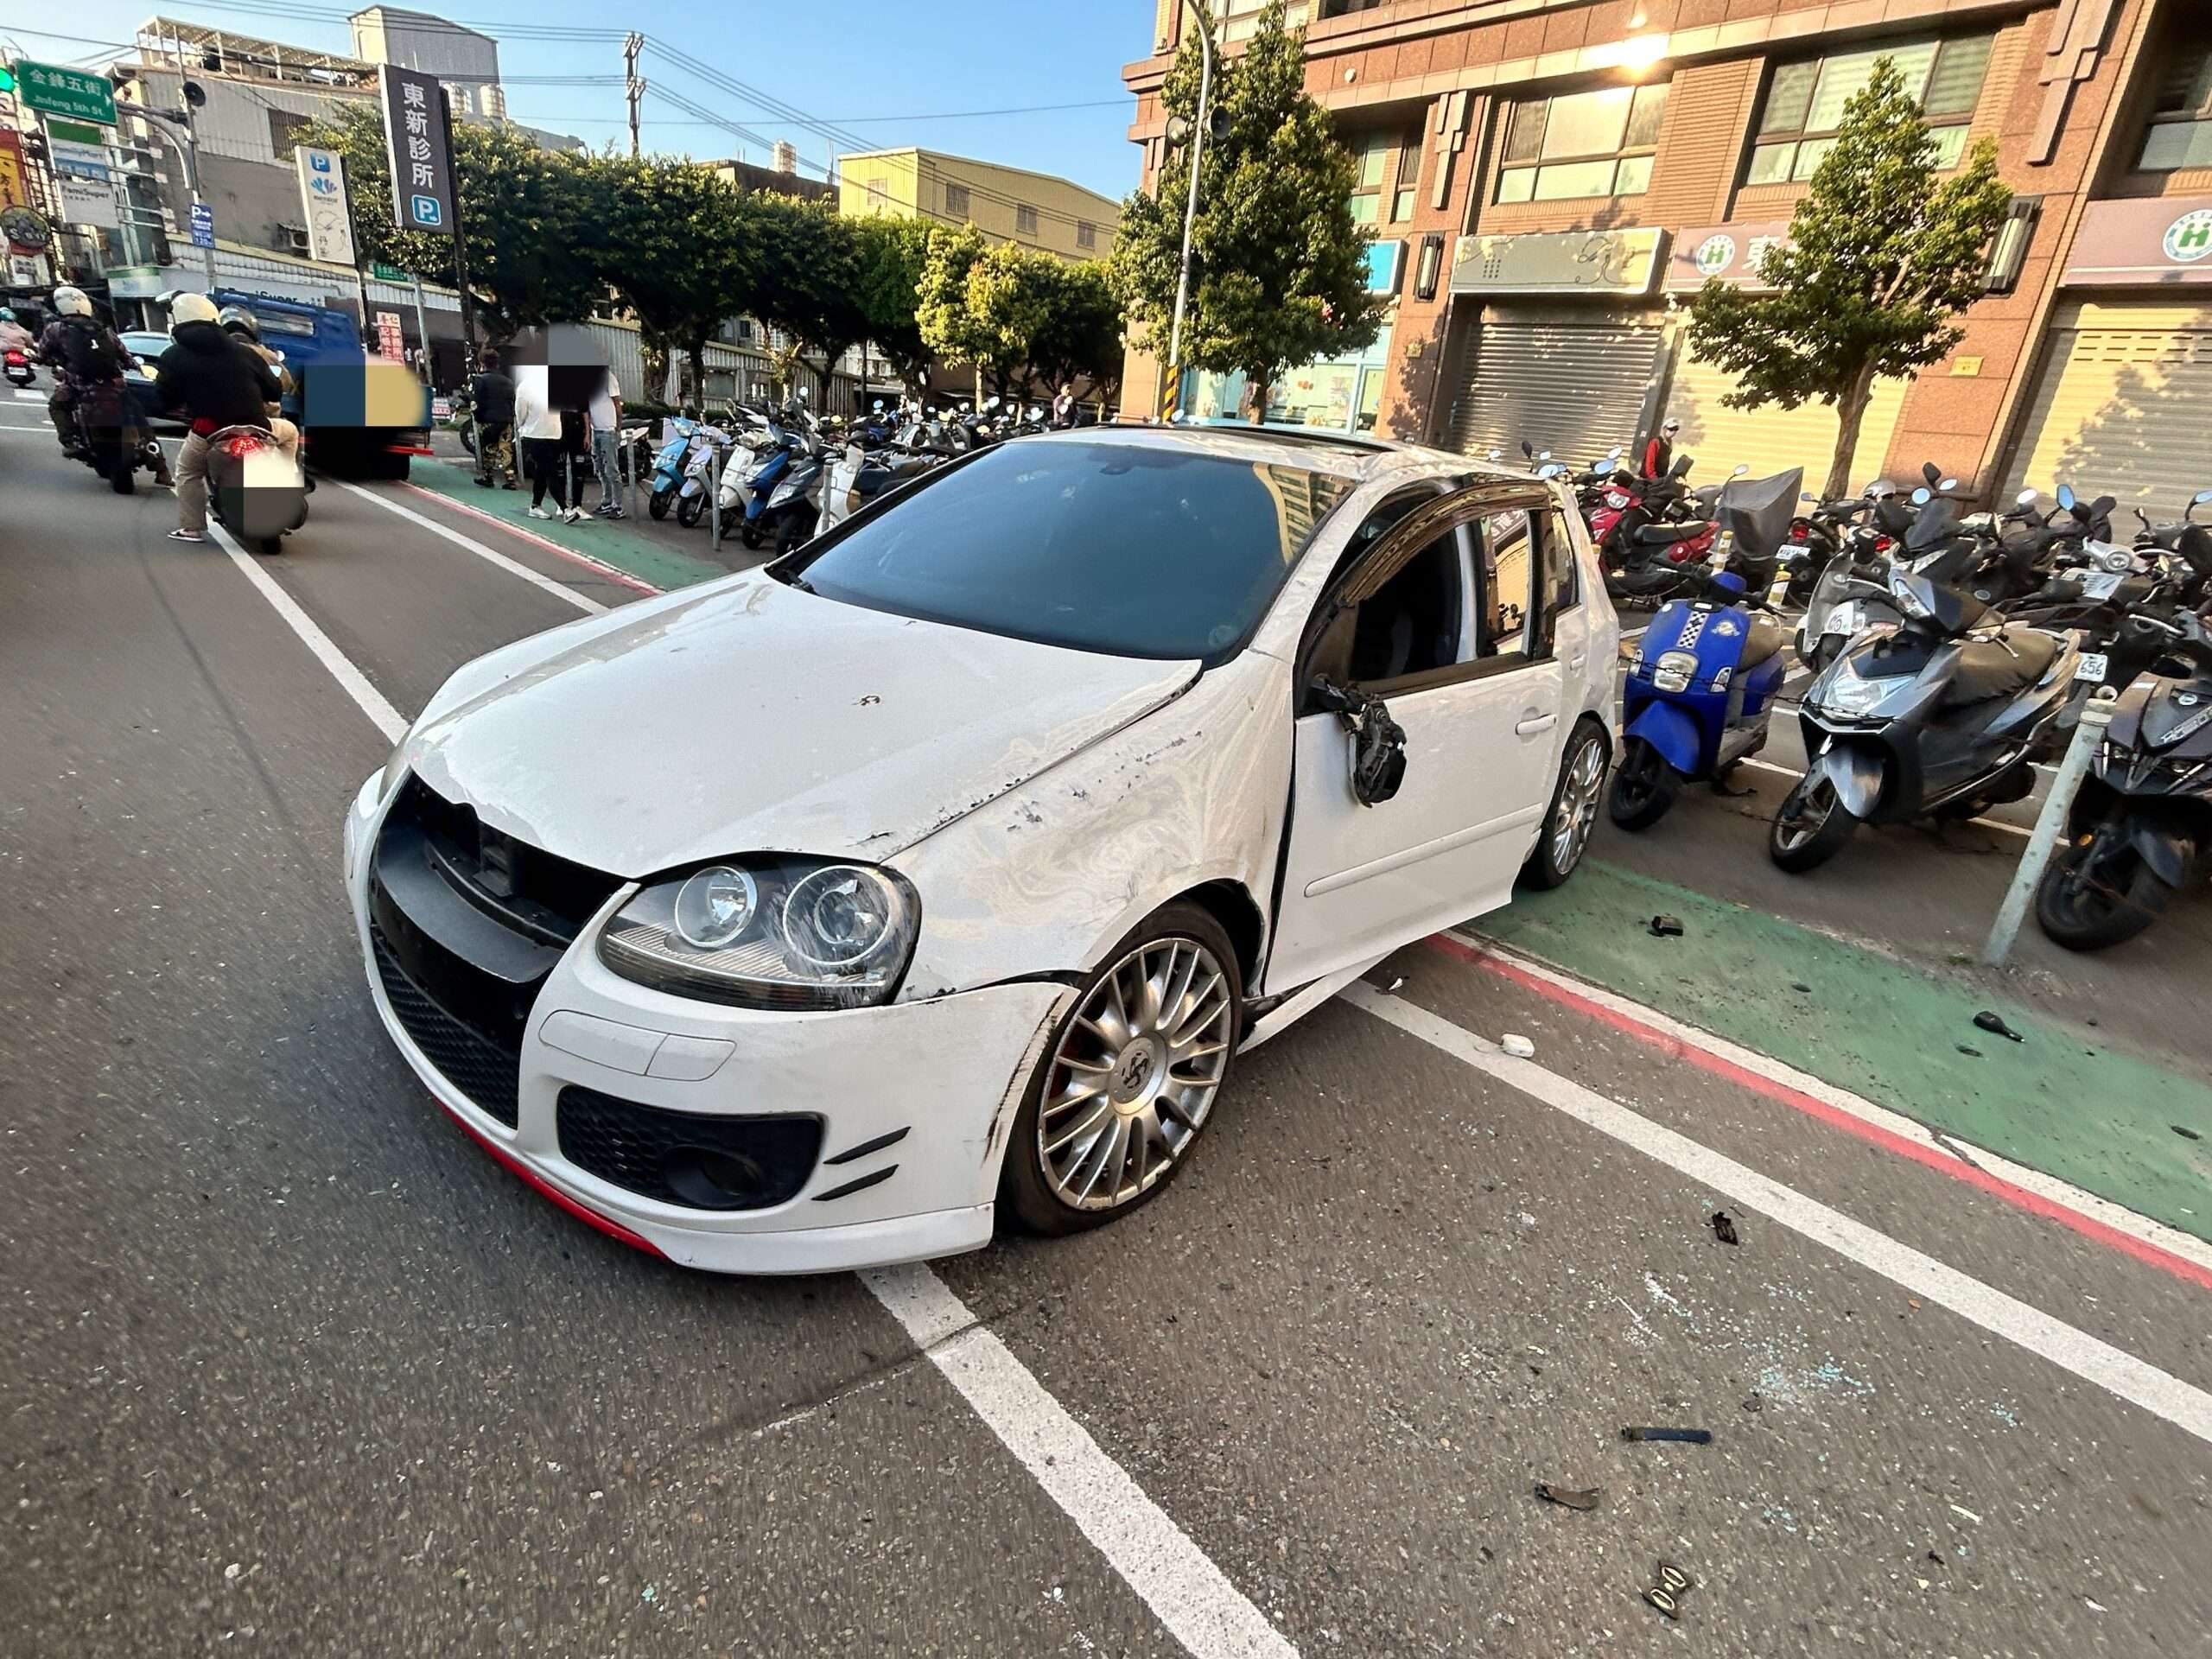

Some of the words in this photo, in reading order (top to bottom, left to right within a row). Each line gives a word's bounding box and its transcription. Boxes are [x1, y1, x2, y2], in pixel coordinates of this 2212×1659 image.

[401, 82, 434, 188] 東新診所
[192, 206, 200, 218] P
[417, 199, 435, 219] P
[2080, 660, 2103, 676] 656
